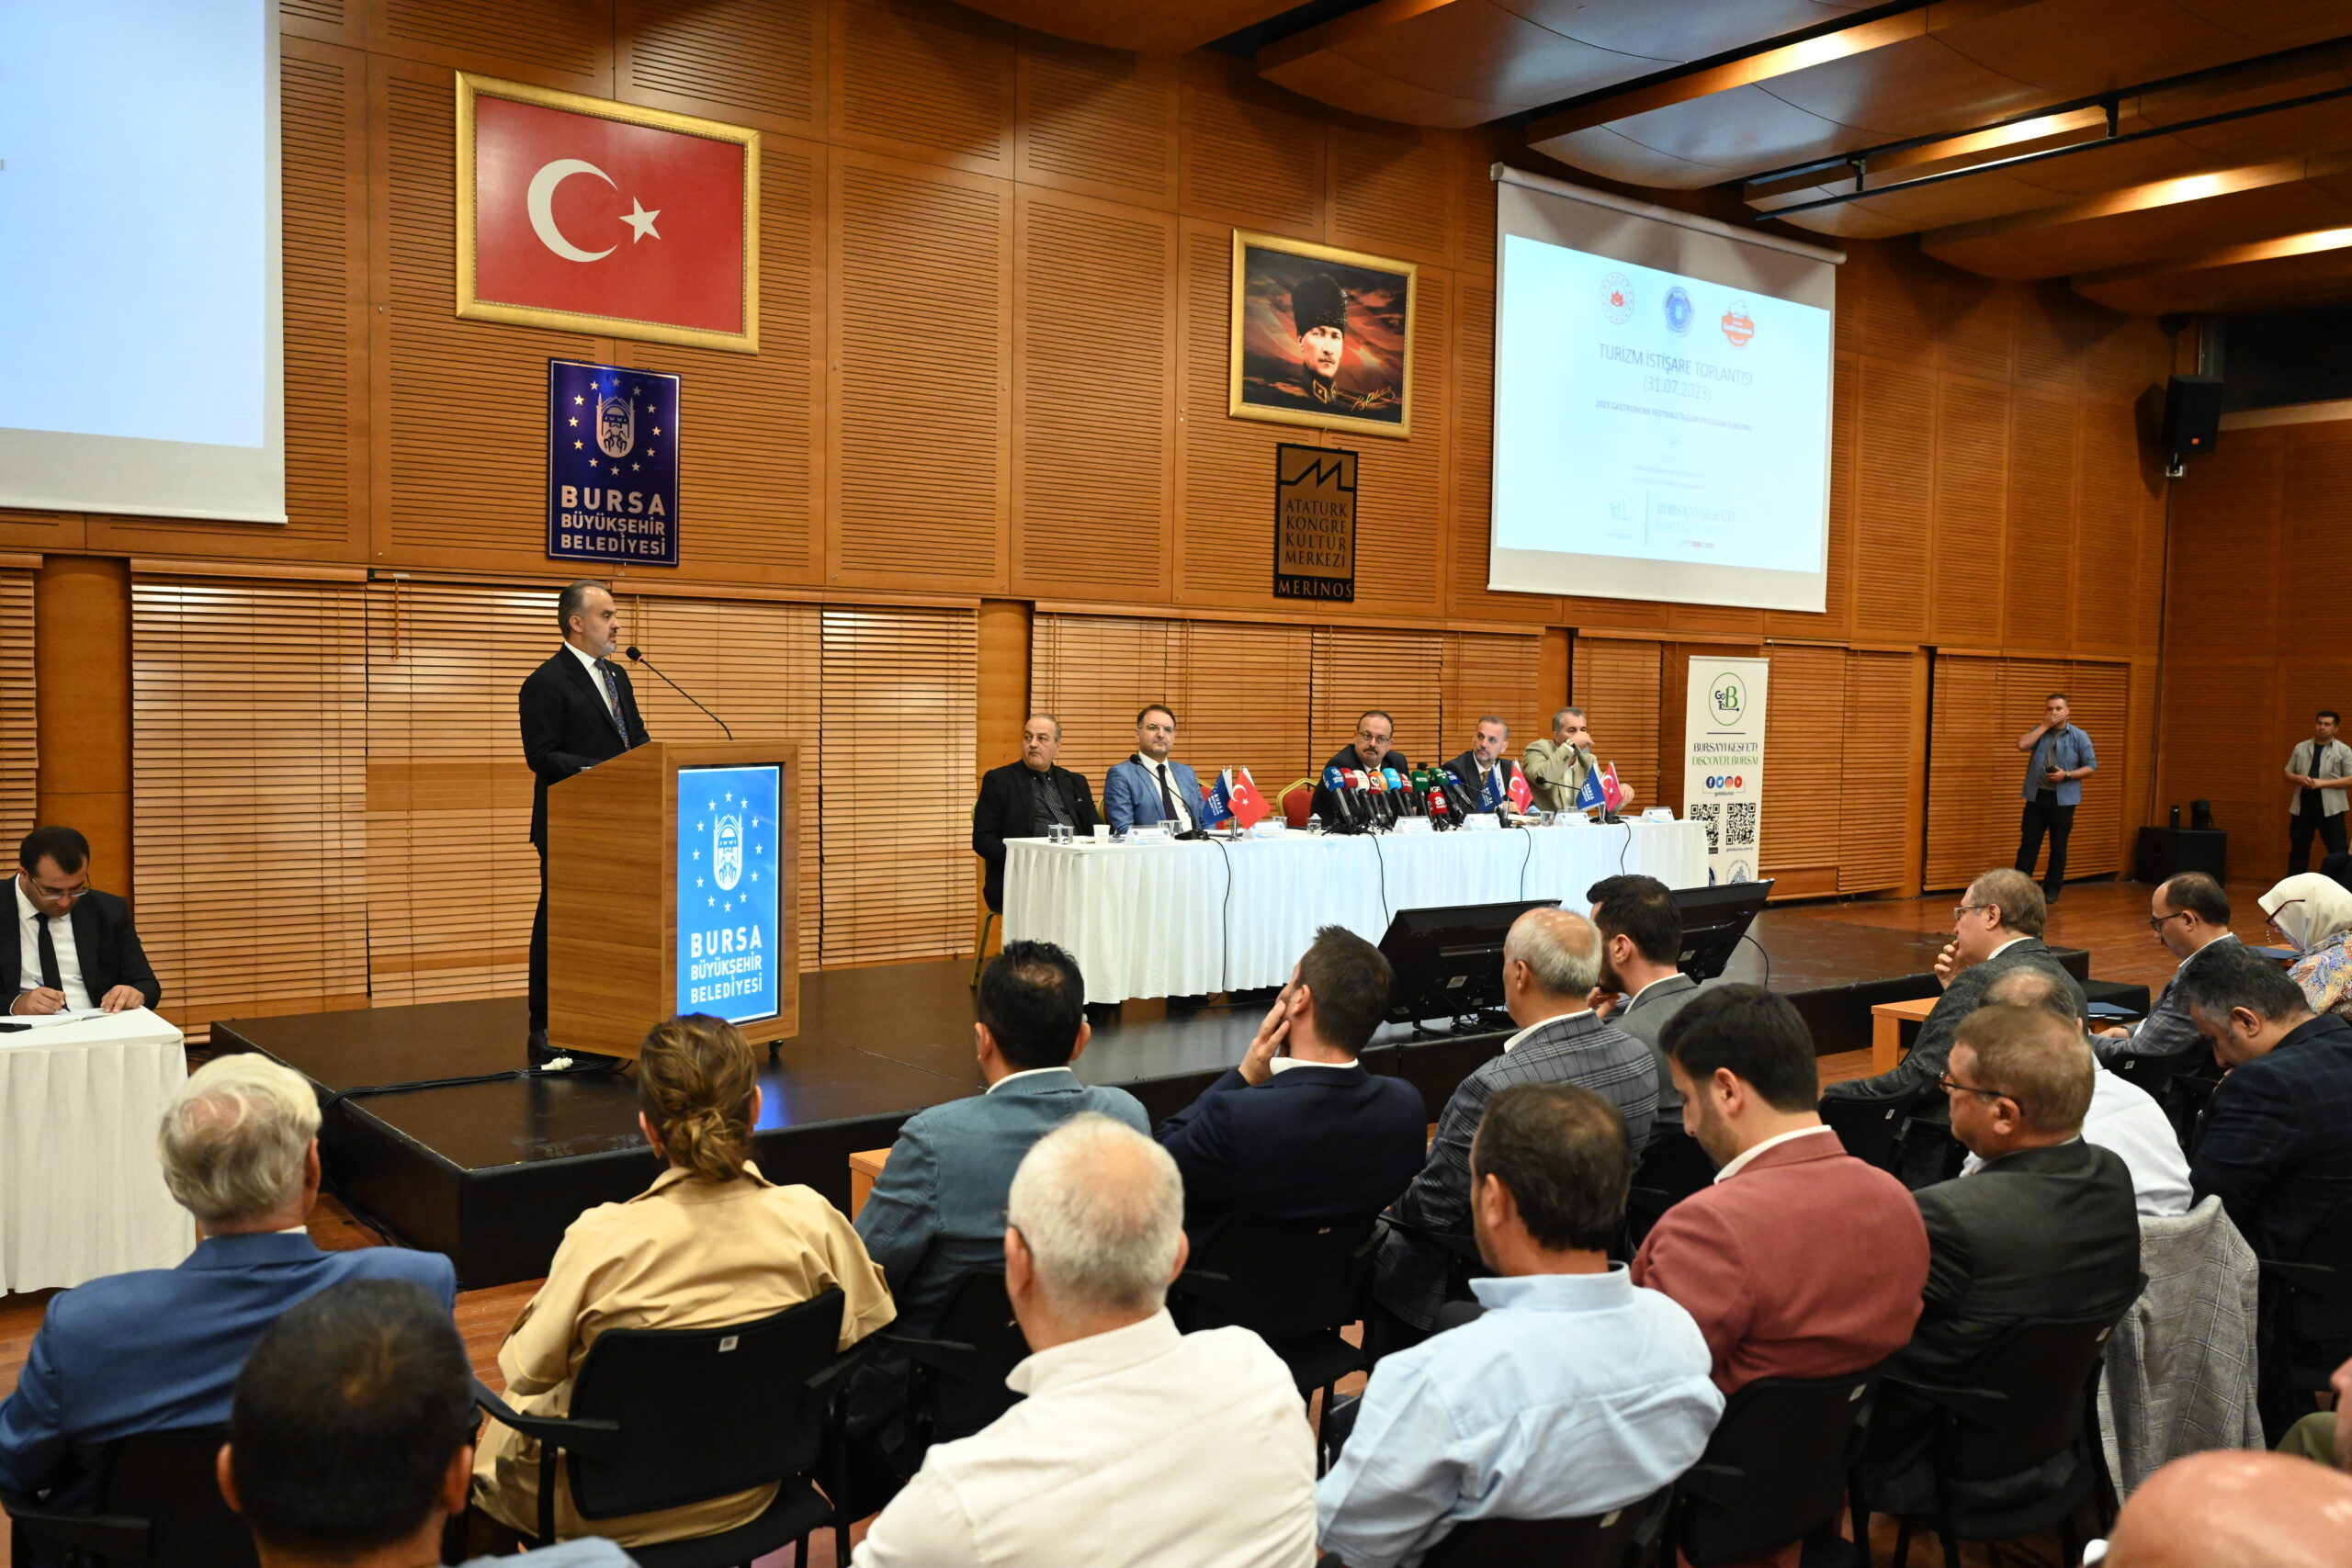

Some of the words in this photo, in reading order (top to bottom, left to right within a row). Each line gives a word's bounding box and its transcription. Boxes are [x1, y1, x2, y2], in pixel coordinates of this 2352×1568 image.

[1599, 343, 1643, 367] TURİZM
[1646, 350, 1691, 374] İSTİŞARE
[1695, 361, 1753, 386] TOPLANTISI
[1643, 374, 1712, 401] (31.07.2023)
[560, 485, 666, 516] BURSA
[1285, 499, 1348, 517] ATATÜRK
[560, 511, 665, 536] BÜYÜKŞEHİR
[1286, 516, 1347, 534] KONGRE
[560, 533, 666, 556] BELEDİYESİ
[1284, 550, 1346, 568] MERKEZİ
[1278, 579, 1352, 598] MERİNOS
[1692, 755, 1730, 766] DISCOVER
[691, 925, 763, 958] BURSA
[690, 952, 763, 982] BÜYÜKŞEHİR
[690, 973, 763, 1004] BELEDİYESİ
